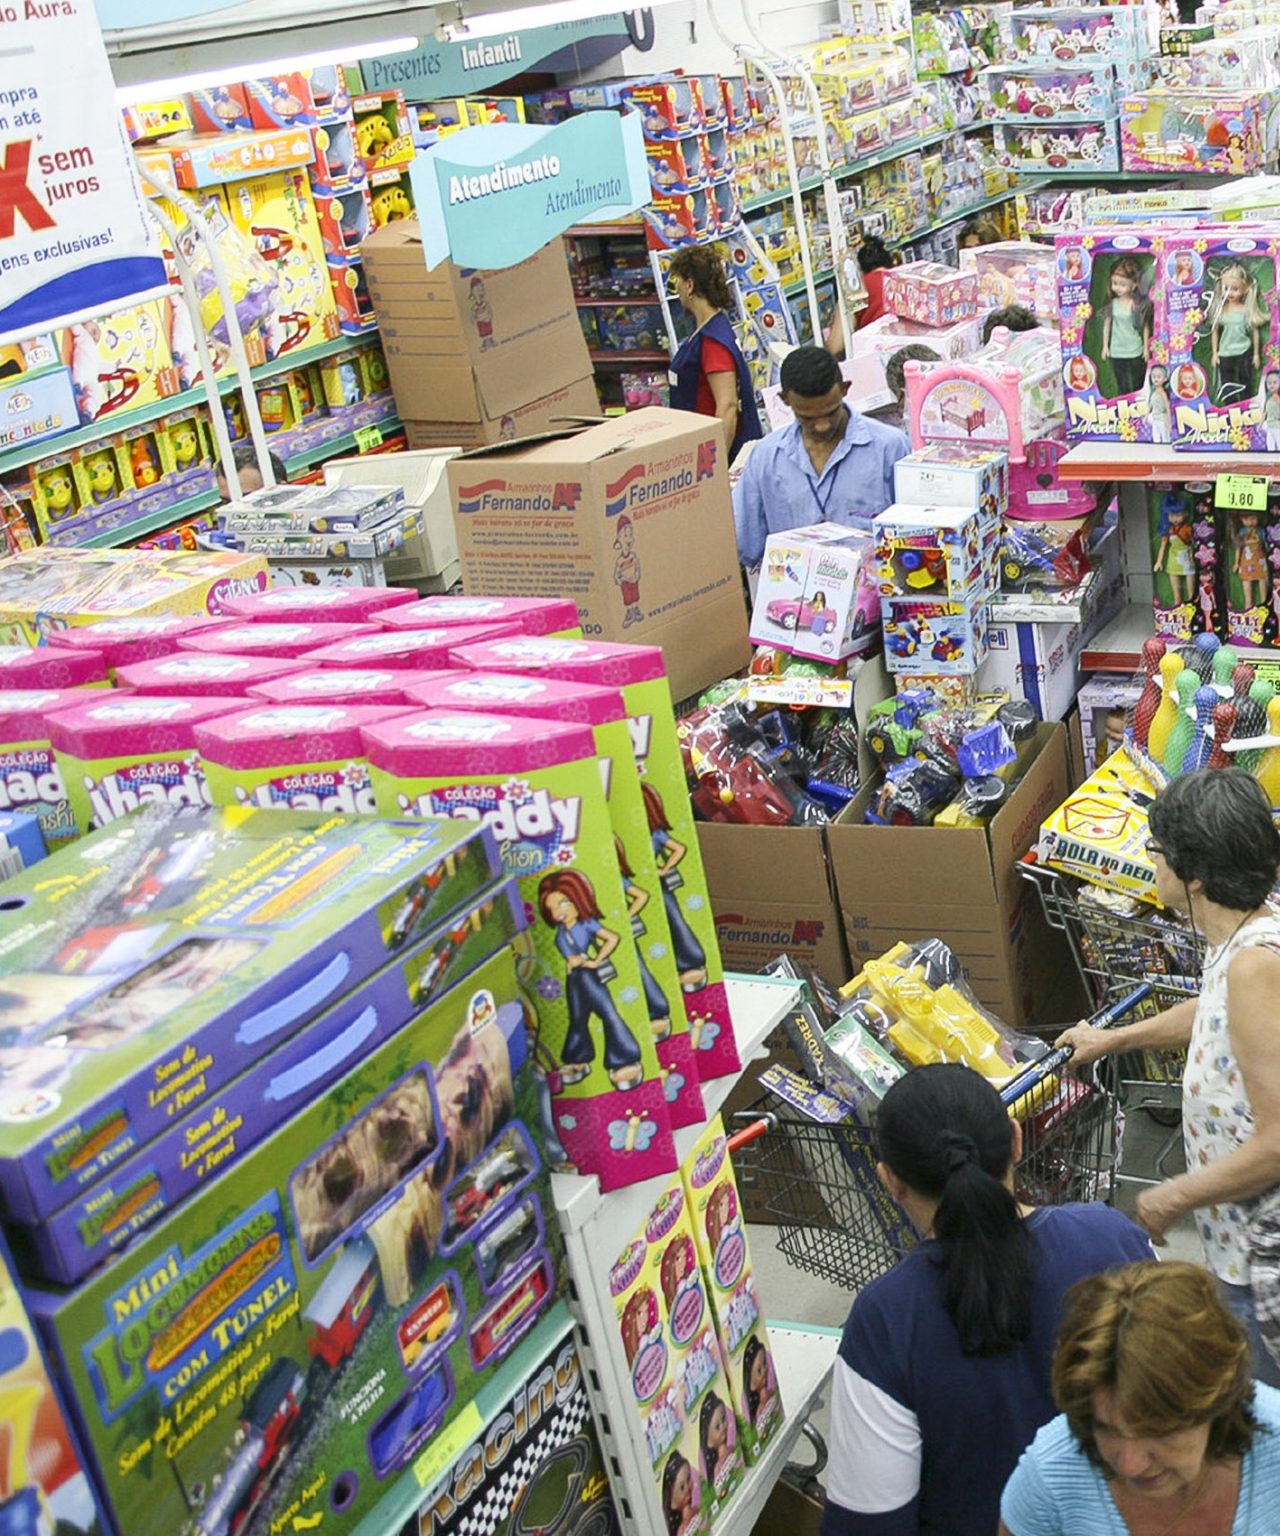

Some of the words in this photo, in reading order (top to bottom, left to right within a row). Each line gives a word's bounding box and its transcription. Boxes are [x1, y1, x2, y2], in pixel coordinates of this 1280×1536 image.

[372, 52, 441, 87] Presentes
[461, 36, 522, 71] Infantil
[14, 108, 42, 126] até
[38, 146, 94, 176] sem
[44, 175, 100, 206] juros
[448, 153, 560, 205] Atendimento
[545, 177, 621, 215] Atendimento
[34, 227, 115, 263] exclusivas!
[1068, 395, 1149, 427] Nicki
[1176, 403, 1263, 433] Nicki
[1077, 420, 1118, 438] Model
[1186, 428, 1230, 446] Model
[482, 494, 551, 511] Fernando
[629, 469, 693, 505] Fernando
[130, 763, 180, 778] COLEÇÃO
[283, 774, 335, 789] COLEÇÃO
[445, 788, 497, 802] COLEÇÃO
[1056, 839, 1098, 866] BOLA
[1100, 855, 1119, 871] NA
[1122, 863, 1157, 885] RED
[718, 927, 790, 944] Fernando
[795, 1014, 825, 1070] XADREZ
[112, 1254, 180, 1324] Mini
[164, 1350, 210, 1398] COM
[212, 1276, 291, 1350] TÚNEL
[119, 1438, 153, 1477] Som
[265, 1290, 300, 1336] Farol
[340, 1368, 387, 1419] FUNCIONA
[358, 1385, 385, 1417] PILHA
